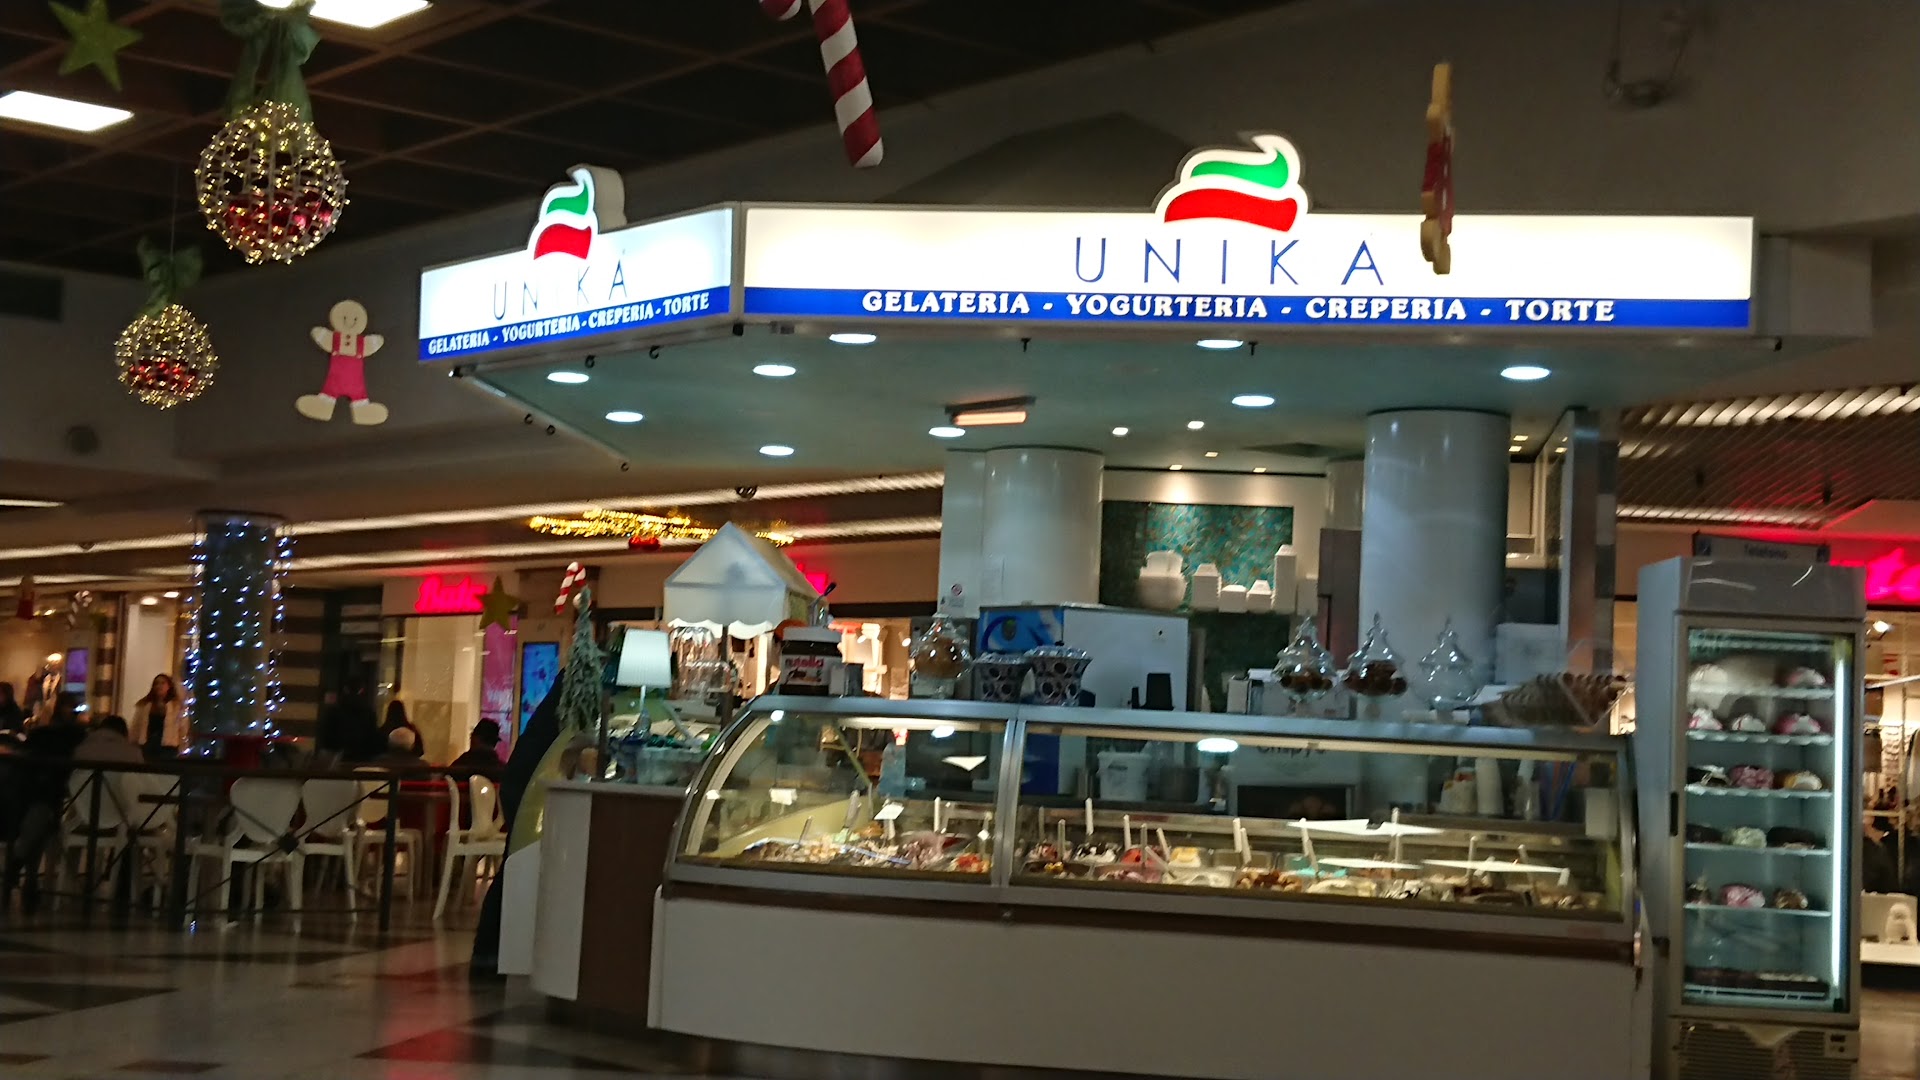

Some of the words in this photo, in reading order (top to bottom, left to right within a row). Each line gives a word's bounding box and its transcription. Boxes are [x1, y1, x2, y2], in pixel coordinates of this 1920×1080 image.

[1076, 237, 1384, 286] UNIKA
[428, 330, 490, 355] GELATERIA
[502, 314, 581, 343] YOGURTERIA
[588, 302, 655, 329] CREPERIA
[663, 292, 710, 316] TORTE
[862, 291, 1031, 314] GELATERIA
[1066, 293, 1268, 318] YOGURTERIA
[1305, 297, 1467, 320] CREPERIA
[1505, 299, 1615, 322] TORTE
